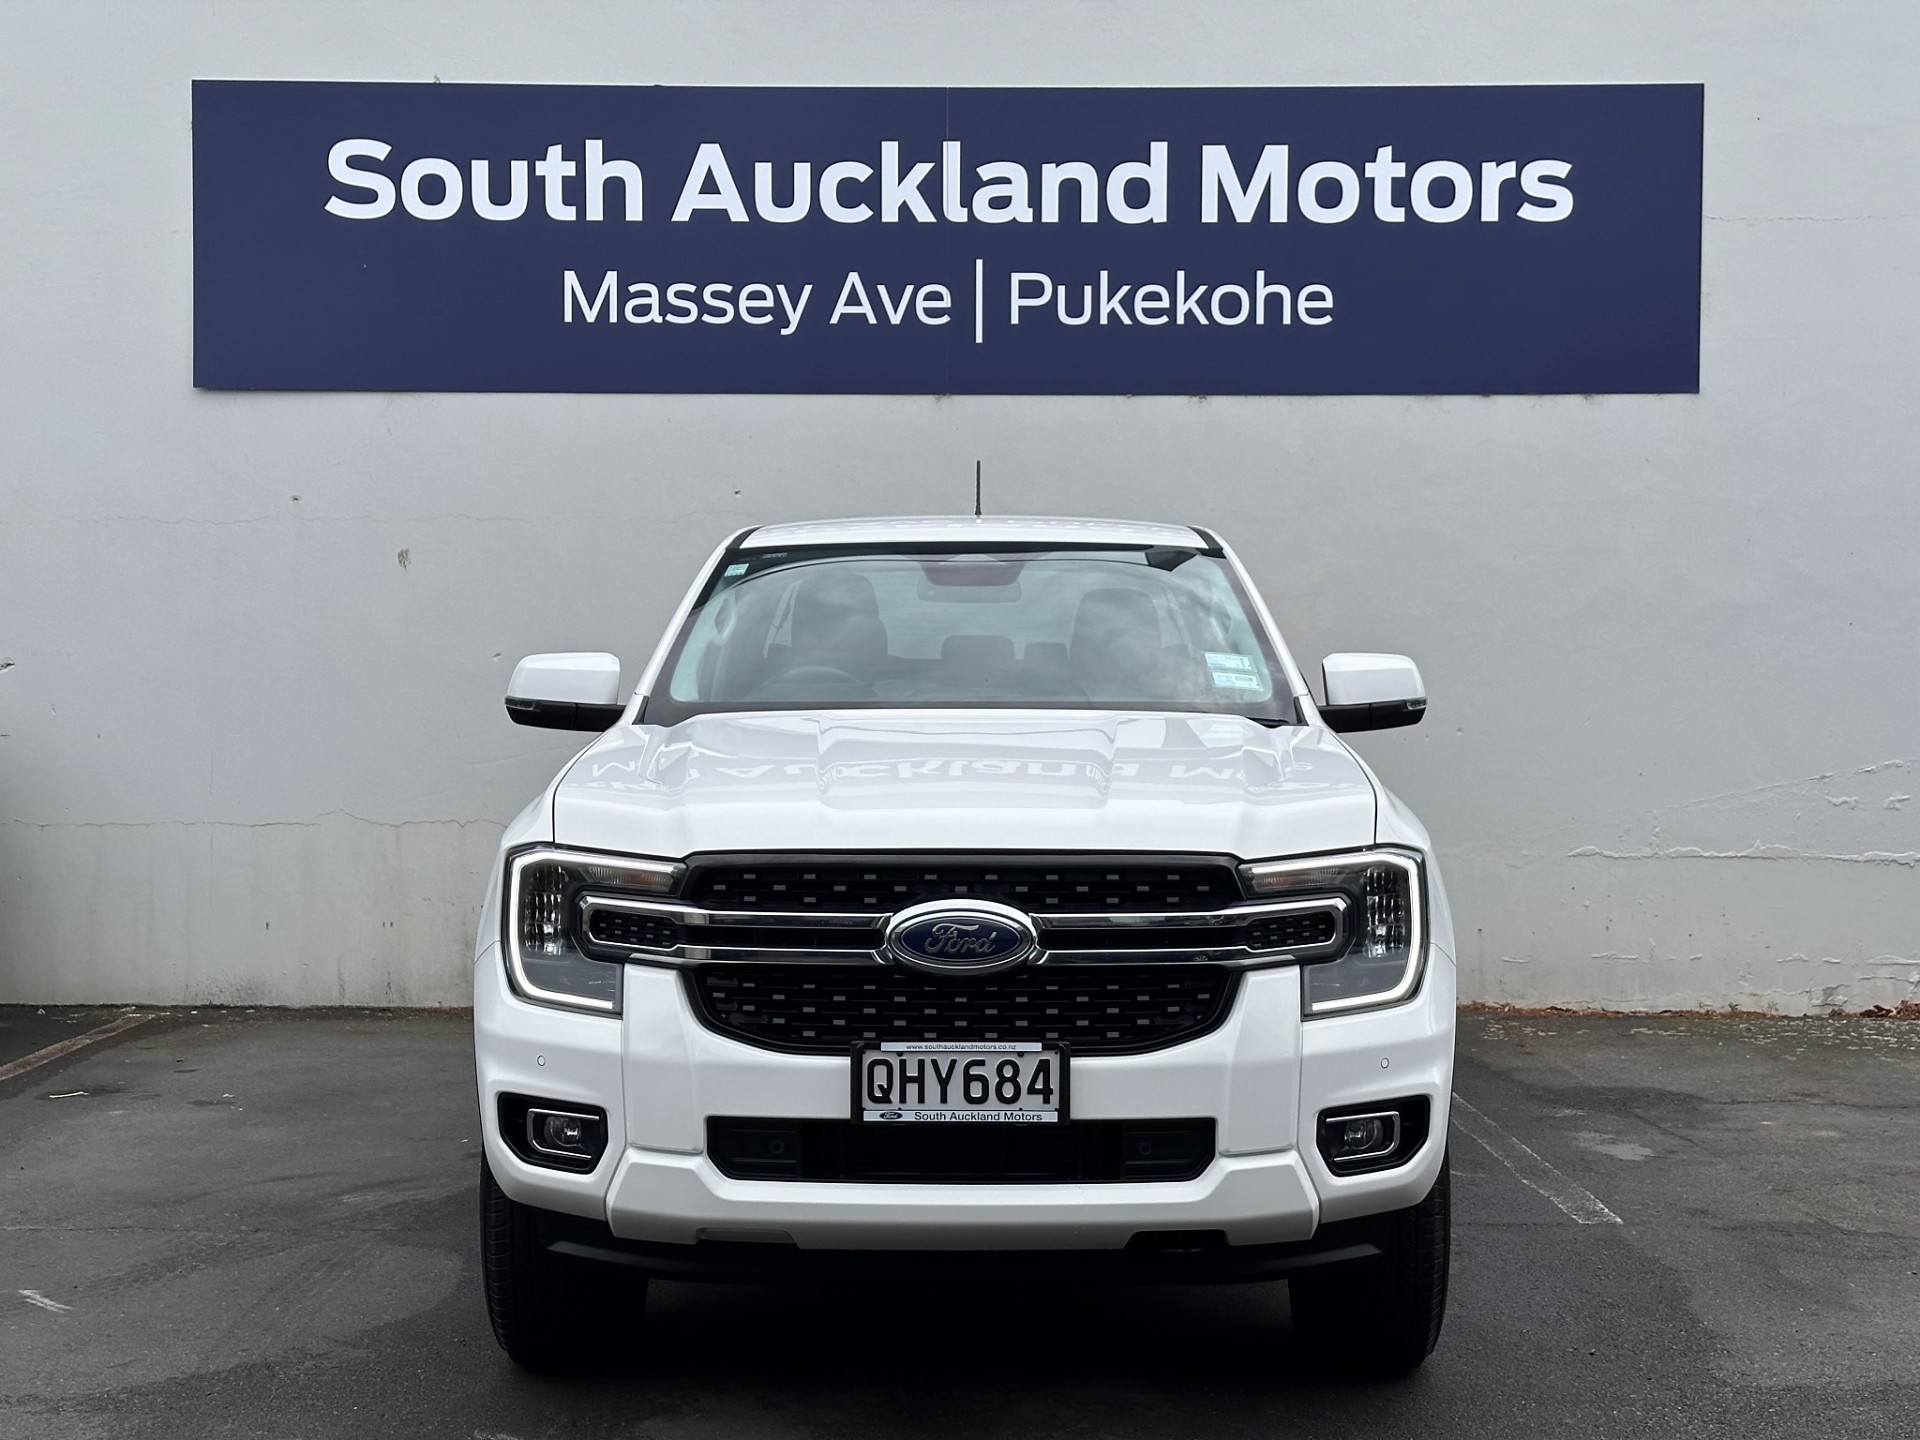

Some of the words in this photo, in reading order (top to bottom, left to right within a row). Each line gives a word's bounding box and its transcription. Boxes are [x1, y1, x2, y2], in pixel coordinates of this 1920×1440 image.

[324, 138, 643, 222] South
[671, 140, 1168, 225] Auckland
[1201, 144, 1575, 224] Motors
[563, 270, 813, 335] Massey
[829, 271, 952, 325] Ave
[1010, 270, 1334, 326] Pukekohe
[924, 922, 997, 954] Ford
[906, 1043, 1017, 1051] www.southaucklandmotors.co.nz
[866, 1058, 1054, 1105] QHY684
[914, 1111, 947, 1121] South
[949, 1111, 1001, 1121] Auckland
[1003, 1111, 1043, 1121] Motors
